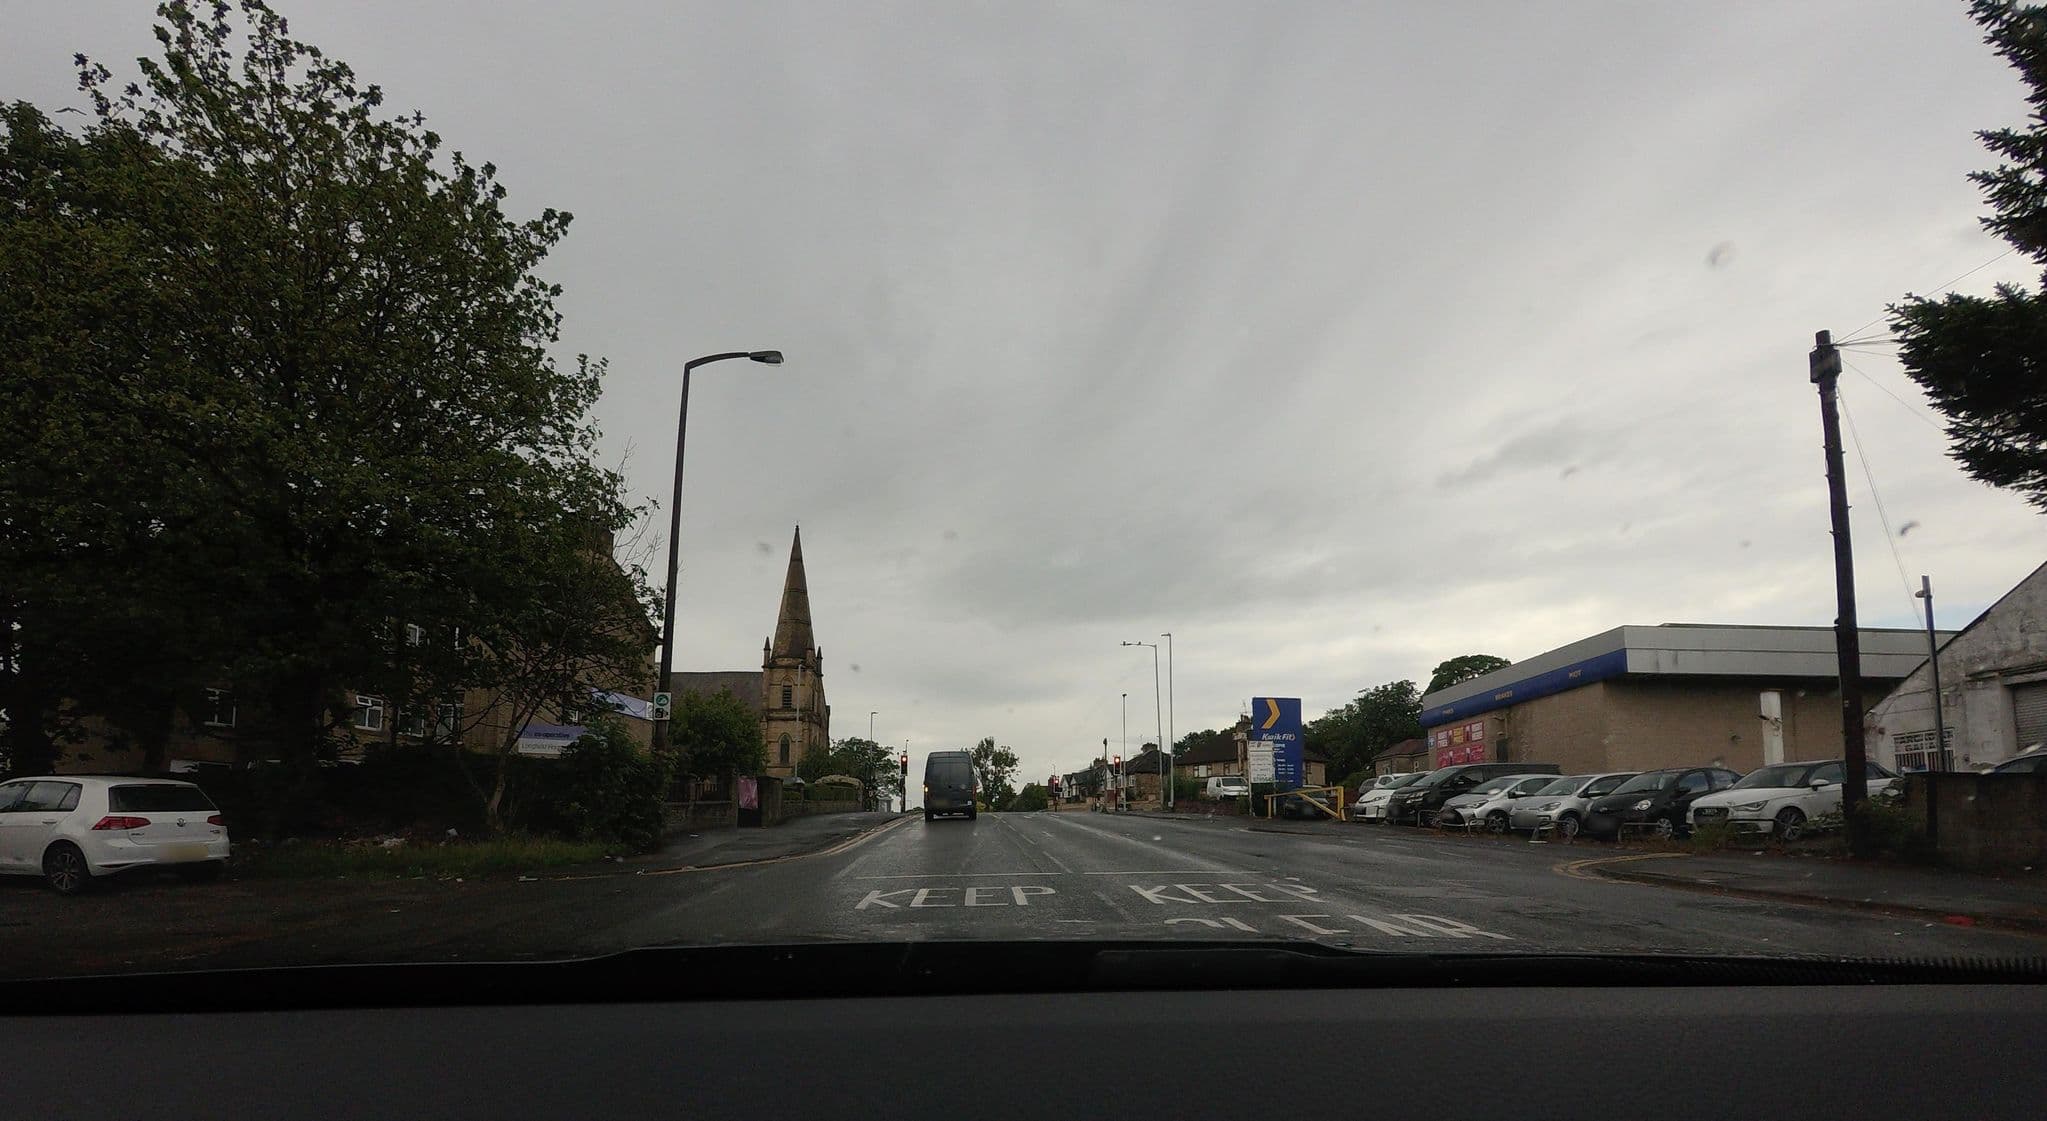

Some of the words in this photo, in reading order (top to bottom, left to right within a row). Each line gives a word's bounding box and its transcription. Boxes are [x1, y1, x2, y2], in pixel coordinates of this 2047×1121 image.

[1262, 733, 1282, 742] Kwik
[855, 886, 1056, 910] KEEP
[1128, 877, 1327, 903] KEEP
